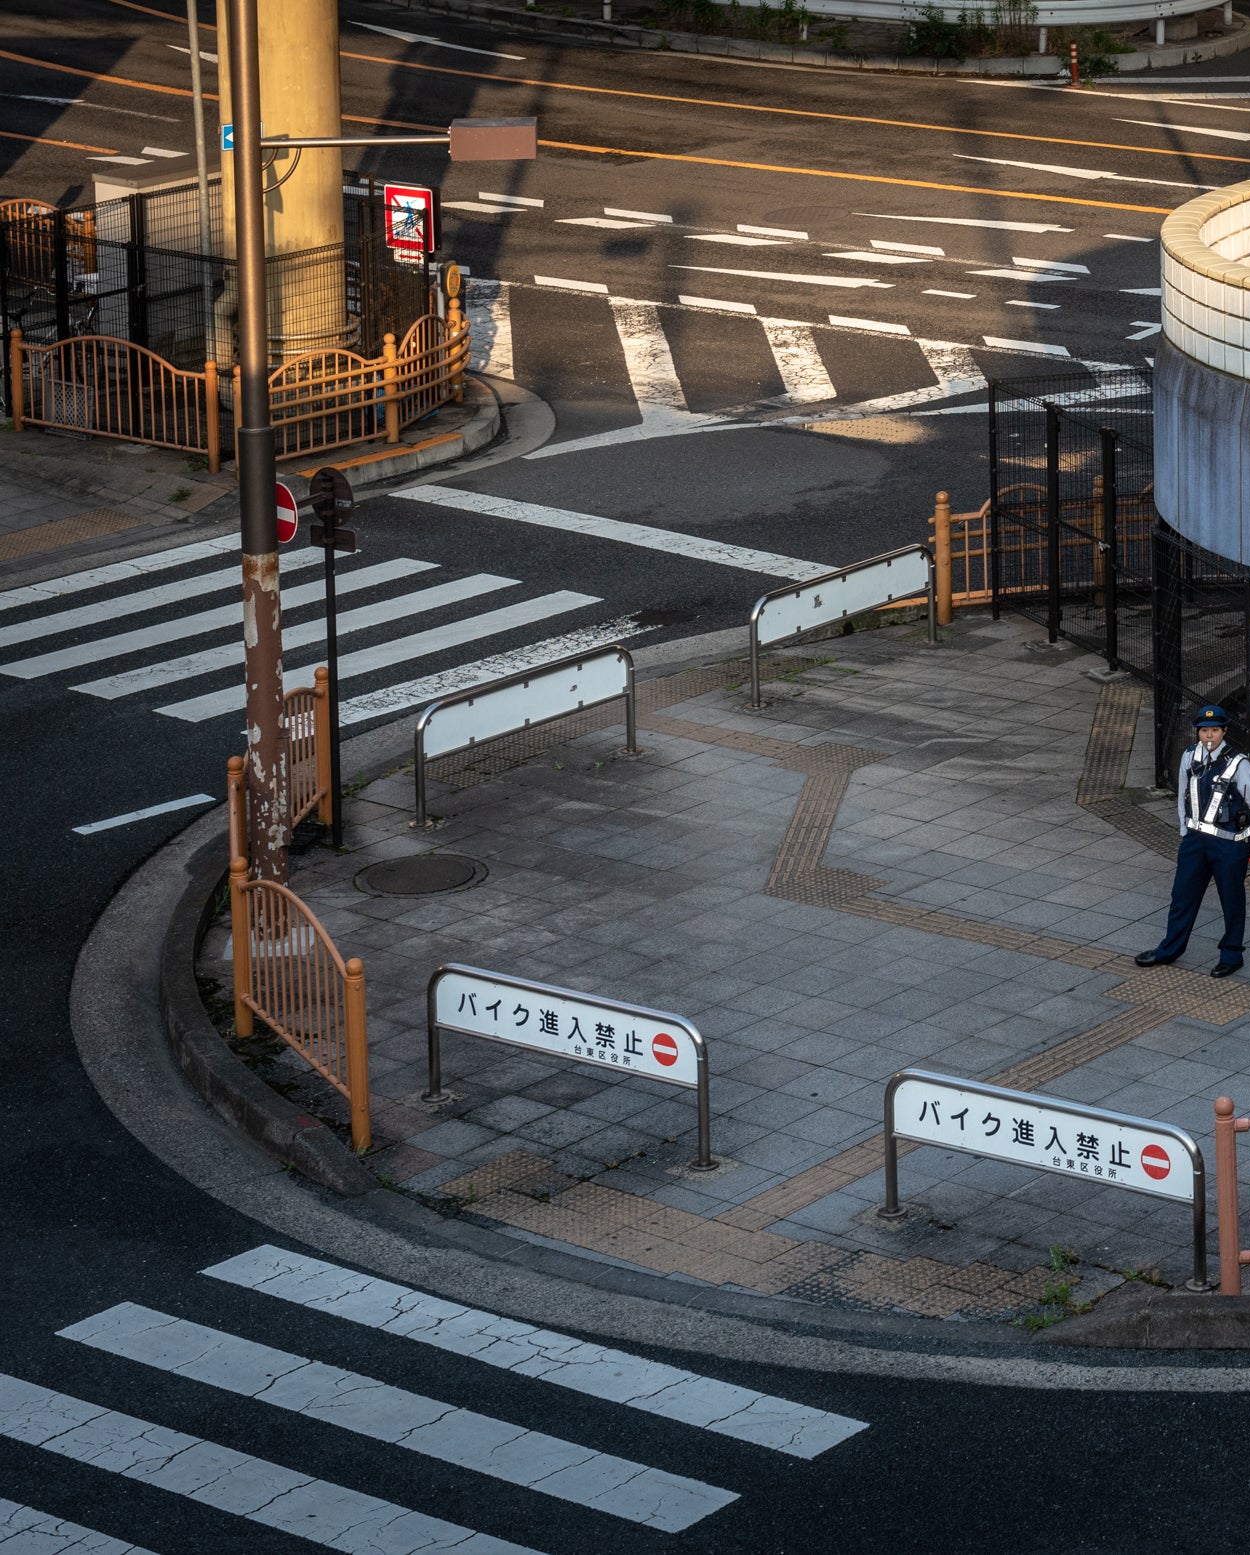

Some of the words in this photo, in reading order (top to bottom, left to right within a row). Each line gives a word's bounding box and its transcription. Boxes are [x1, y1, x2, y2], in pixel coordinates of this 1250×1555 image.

[458, 992, 643, 1057] バイク進入禁止
[574, 1044, 632, 1066] 台東区役所
[919, 1100, 1132, 1170] バイク進入禁止
[1052, 1156, 1118, 1180] 台東区役所
